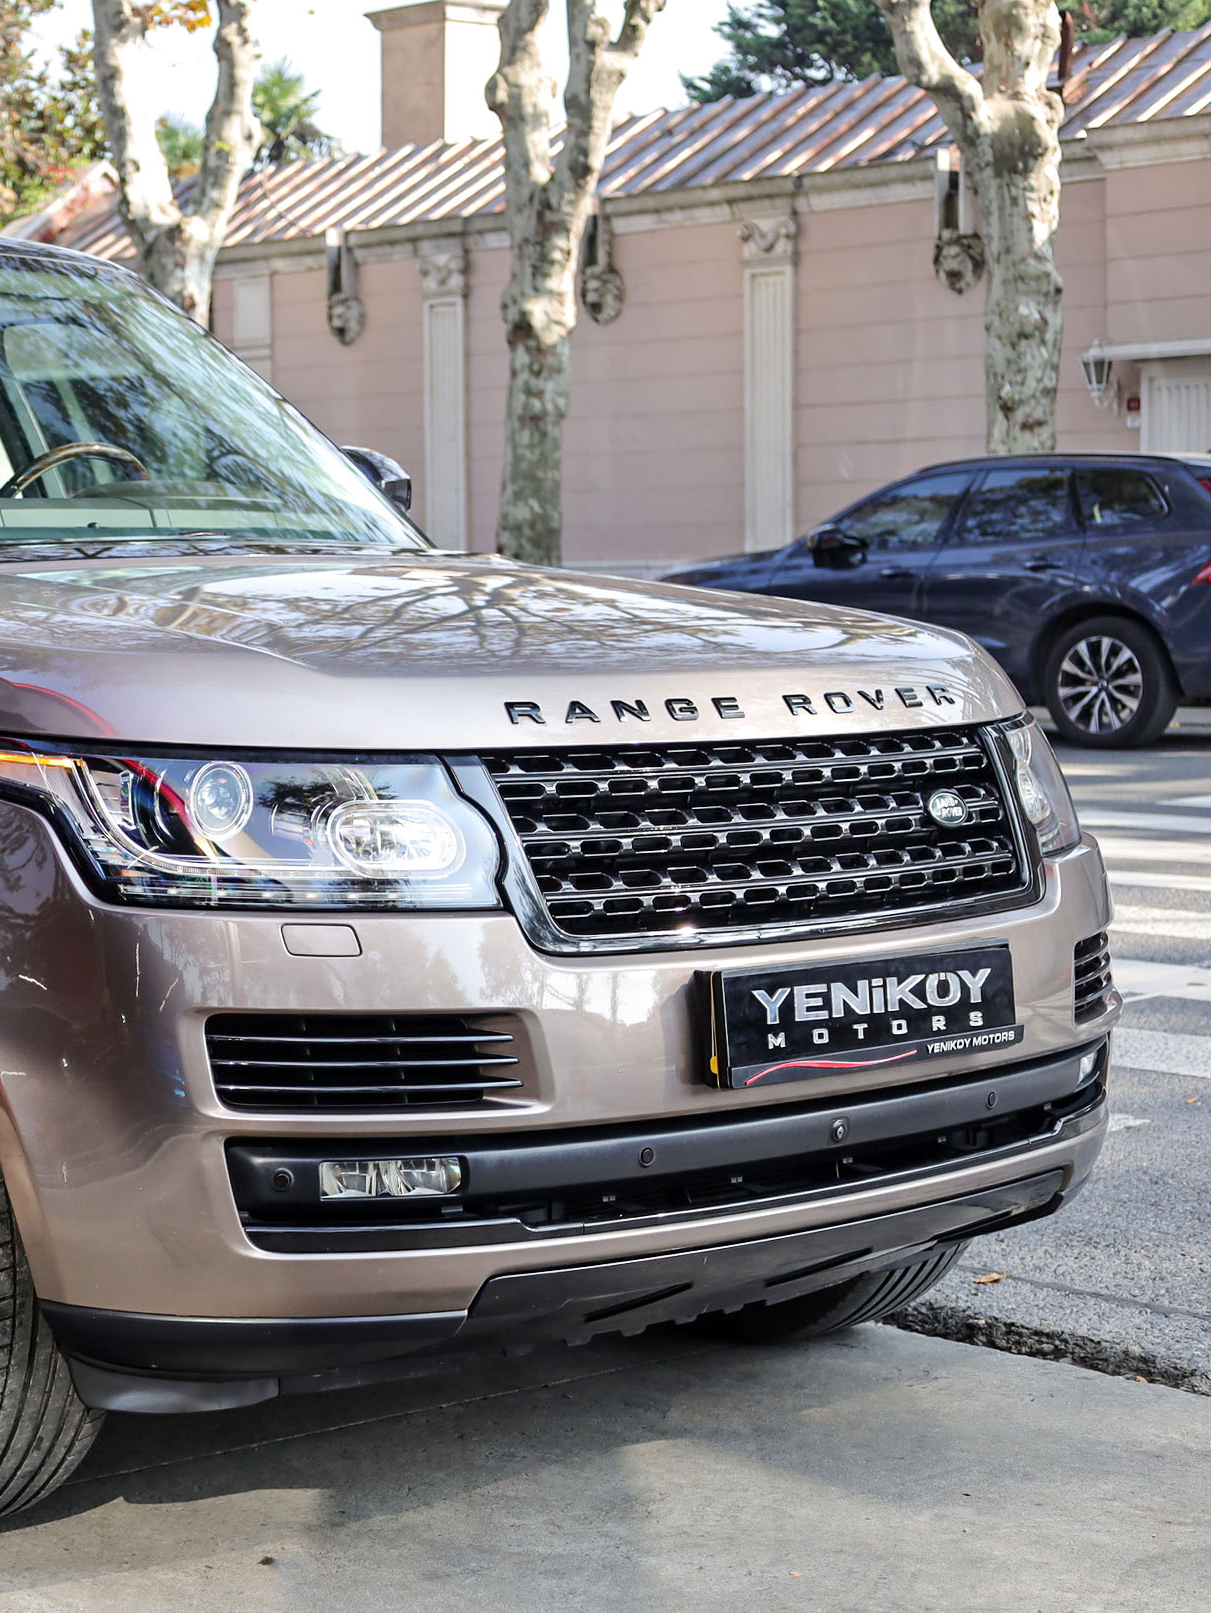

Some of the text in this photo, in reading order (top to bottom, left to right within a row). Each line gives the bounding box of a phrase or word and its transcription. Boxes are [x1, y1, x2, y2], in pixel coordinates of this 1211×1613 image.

[504, 683, 957, 725] RANGE ROVER
[935, 796, 956, 808] LAND
[941, 806, 964, 818] ROVER
[768, 1011, 984, 1049] MOTORS
[972, 1030, 1016, 1047] MOTORS
